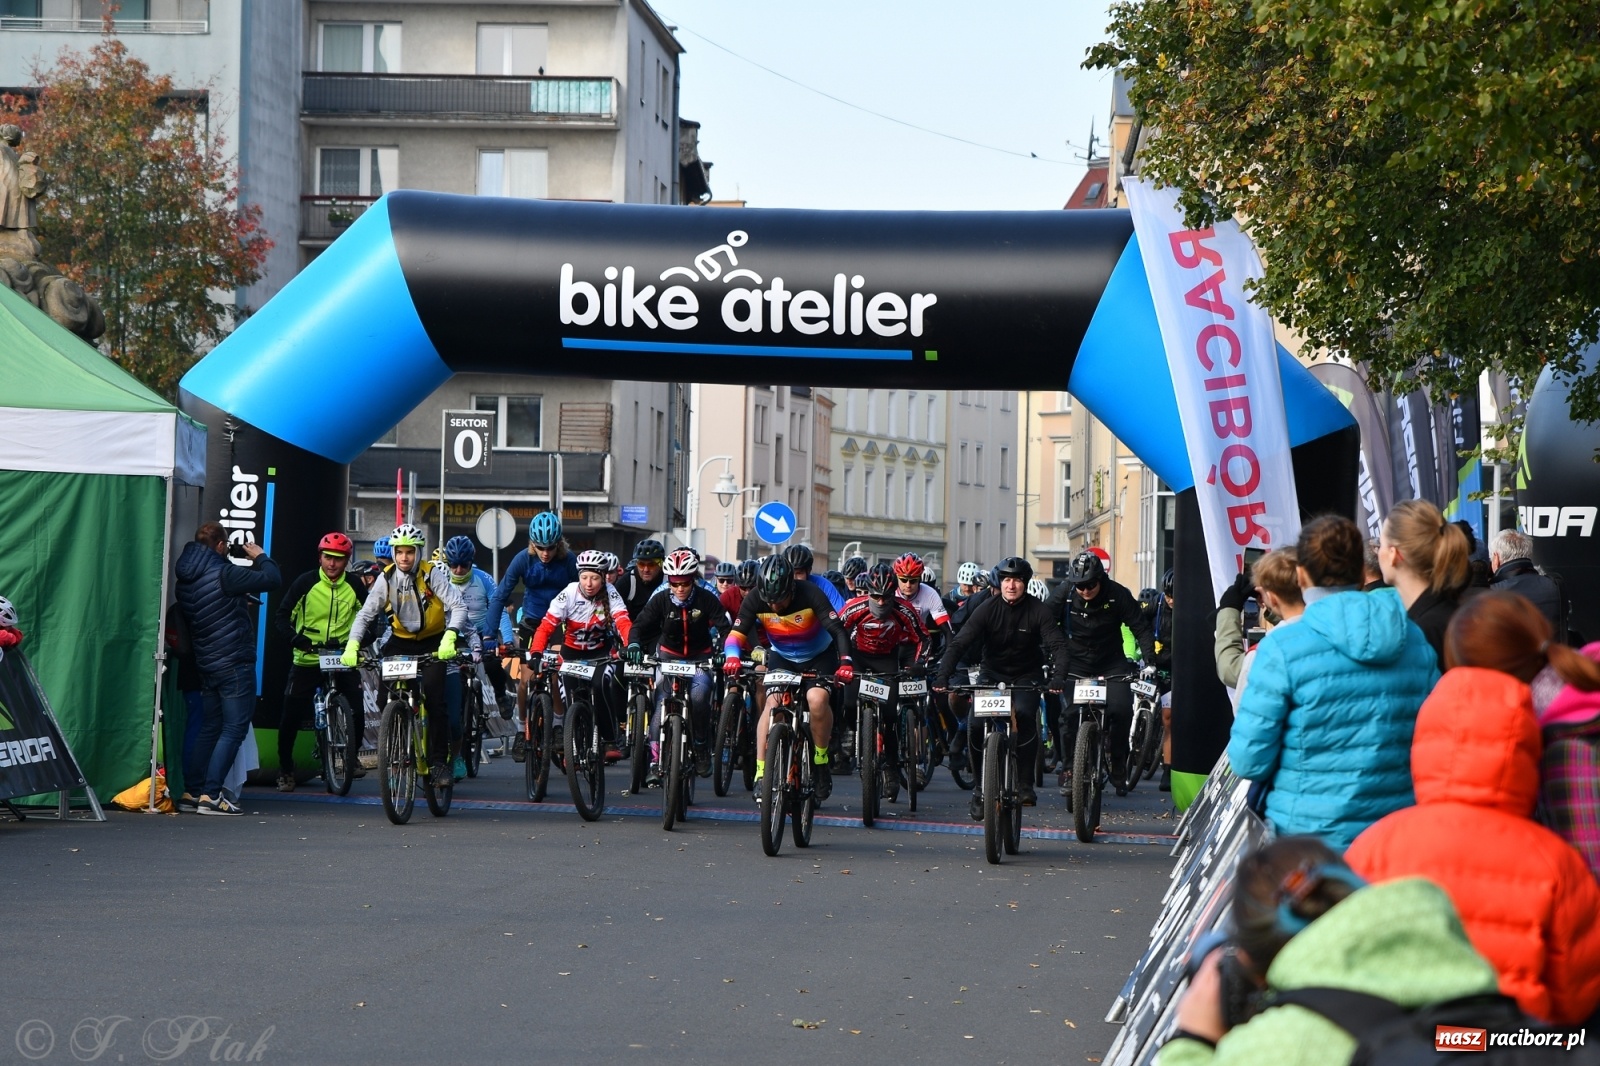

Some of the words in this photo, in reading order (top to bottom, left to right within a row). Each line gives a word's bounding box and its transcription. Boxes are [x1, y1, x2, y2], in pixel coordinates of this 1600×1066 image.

[559, 262, 700, 331] bike
[720, 272, 938, 338] atelier
[450, 418, 488, 428] SEKTOR
[453, 429, 483, 469] 0
[509, 508, 546, 519] DROGERI
[1517, 505, 1598, 537] RIDA
[325, 657, 342, 666] 318
[388, 663, 412, 672] 2479
[668, 665, 691, 673] 3247
[864, 683, 885, 696] 1083
[1078, 689, 1100, 698] 2151
[981, 699, 1006, 708] 2692
[0, 736, 57, 768] ERIDA
